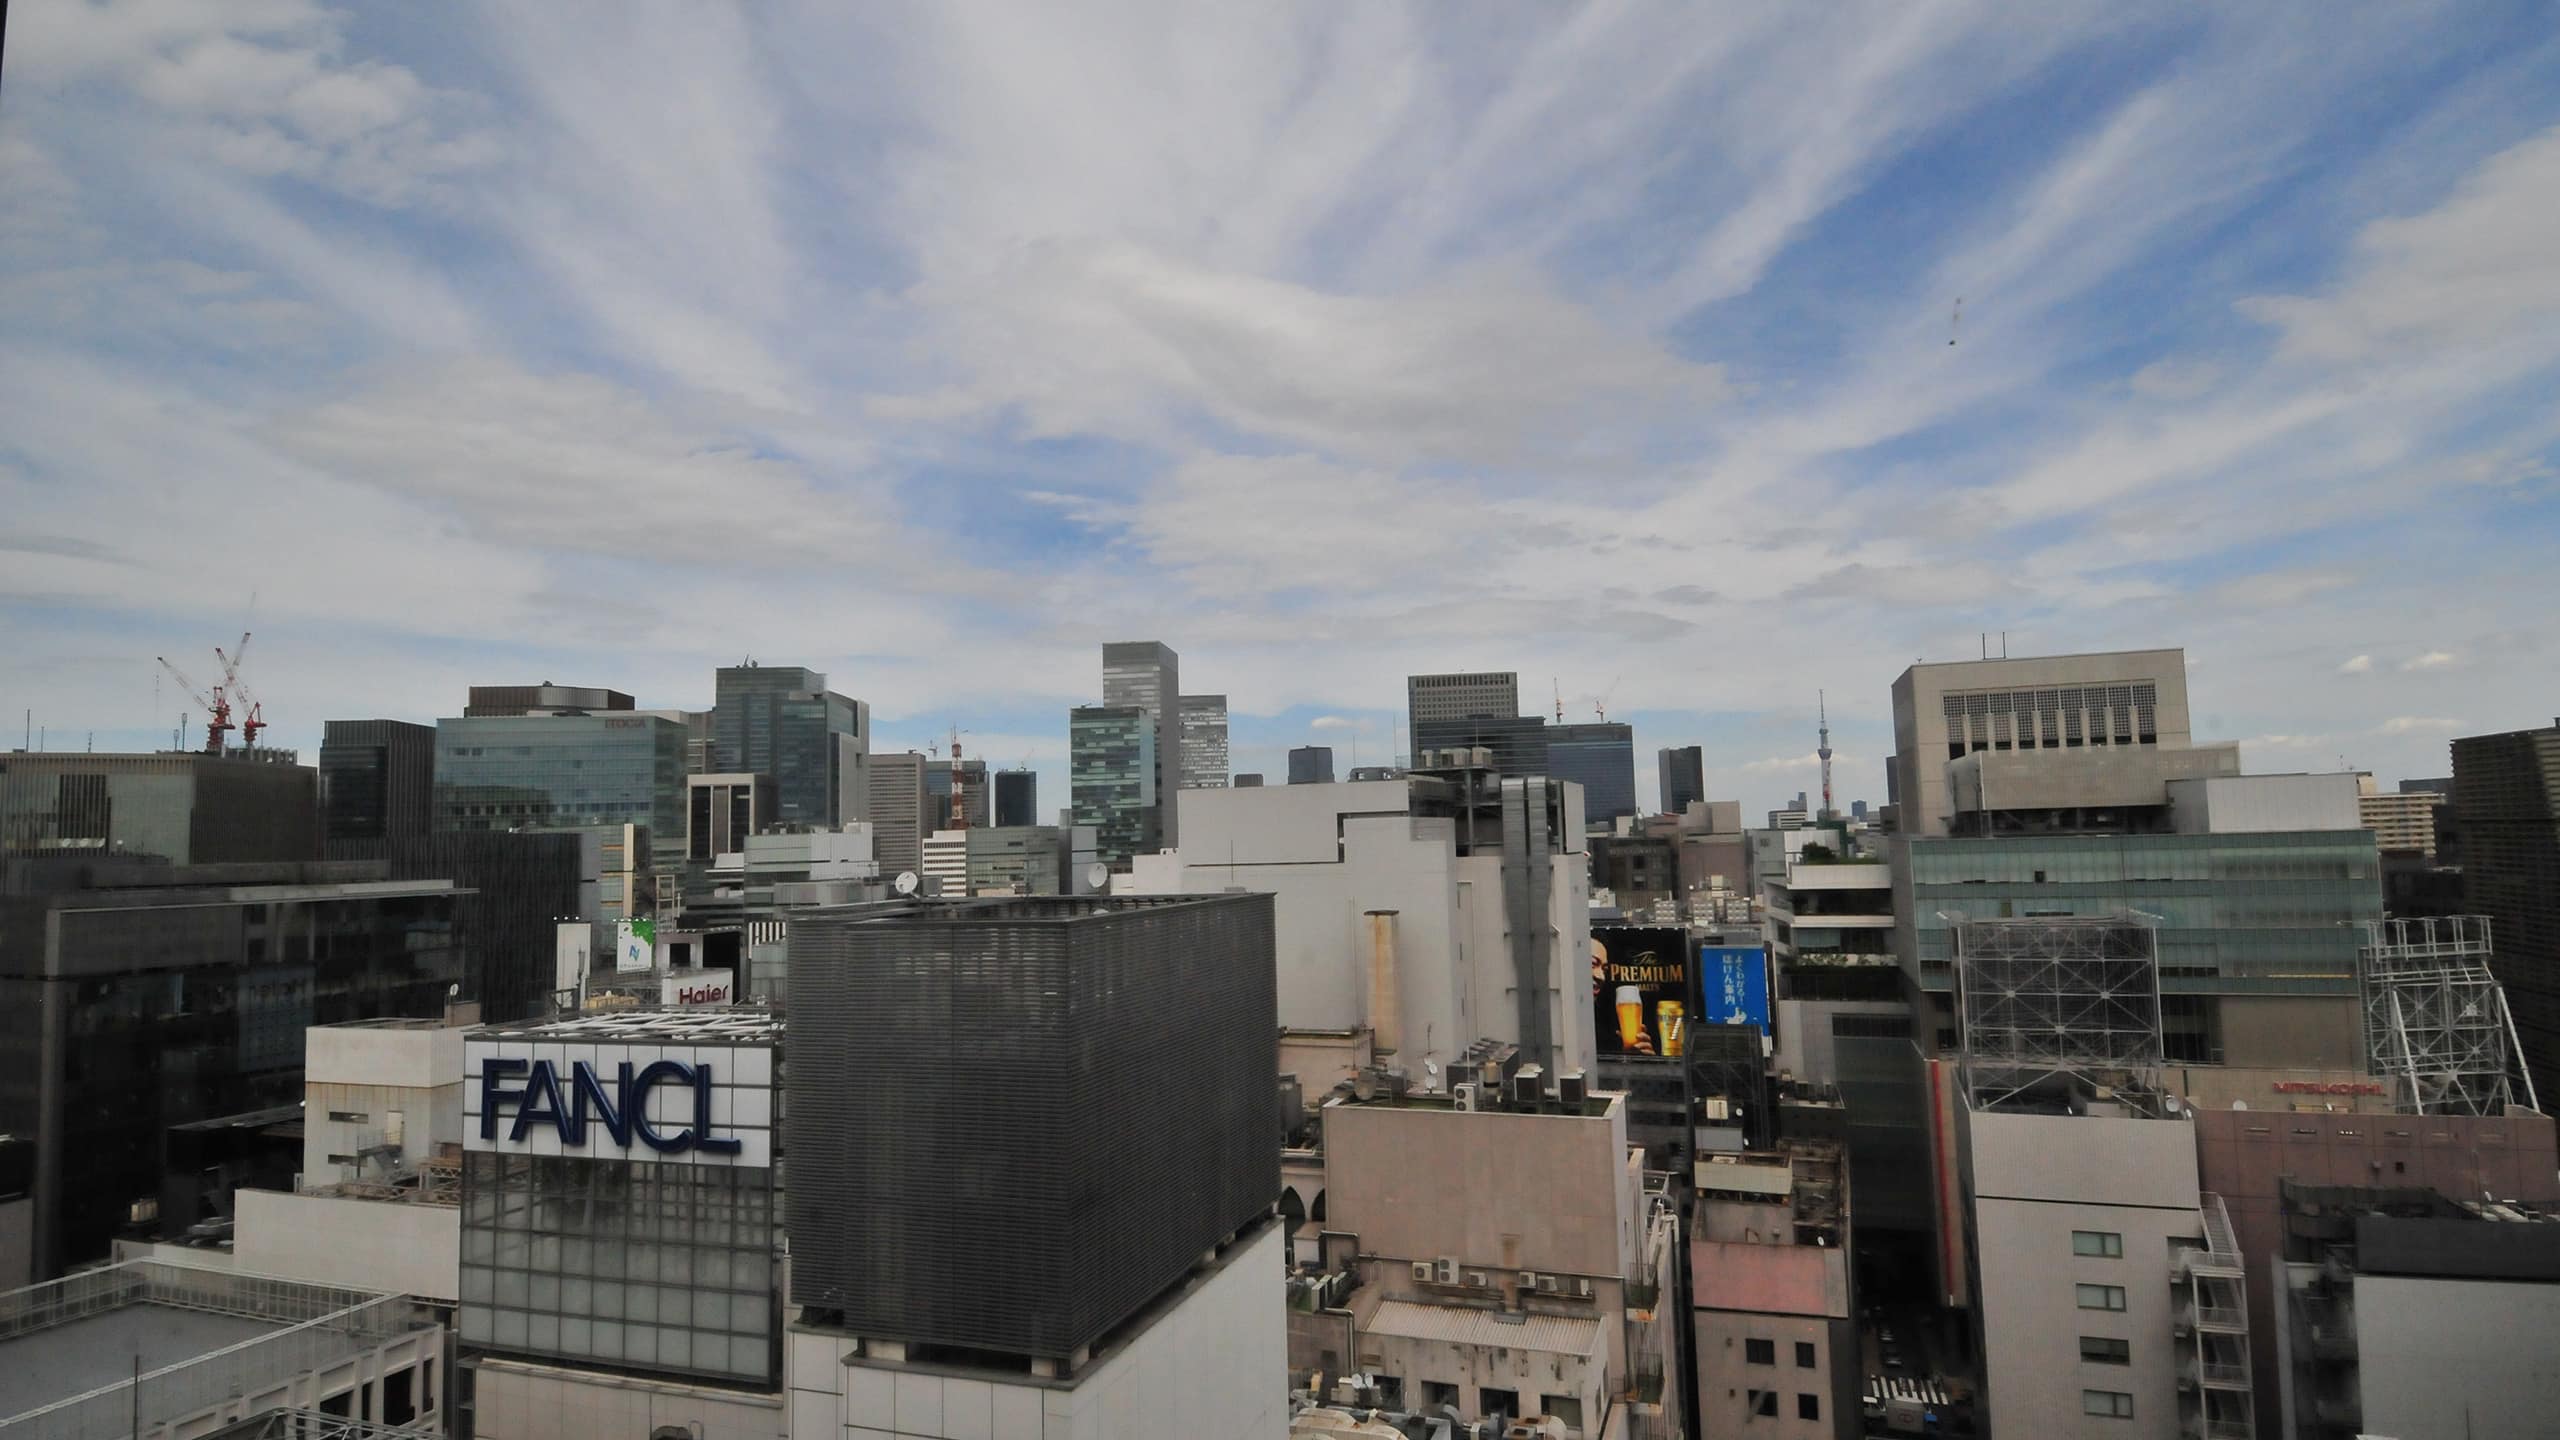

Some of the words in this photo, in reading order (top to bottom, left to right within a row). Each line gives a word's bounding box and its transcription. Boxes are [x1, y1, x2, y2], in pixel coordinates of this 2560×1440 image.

[1610, 963, 1684, 982] PREMIUM
[679, 984, 729, 1005] Haier
[2272, 1082, 2385, 1096] MITSUKOSHI
[480, 1058, 742, 1154] FANCL
